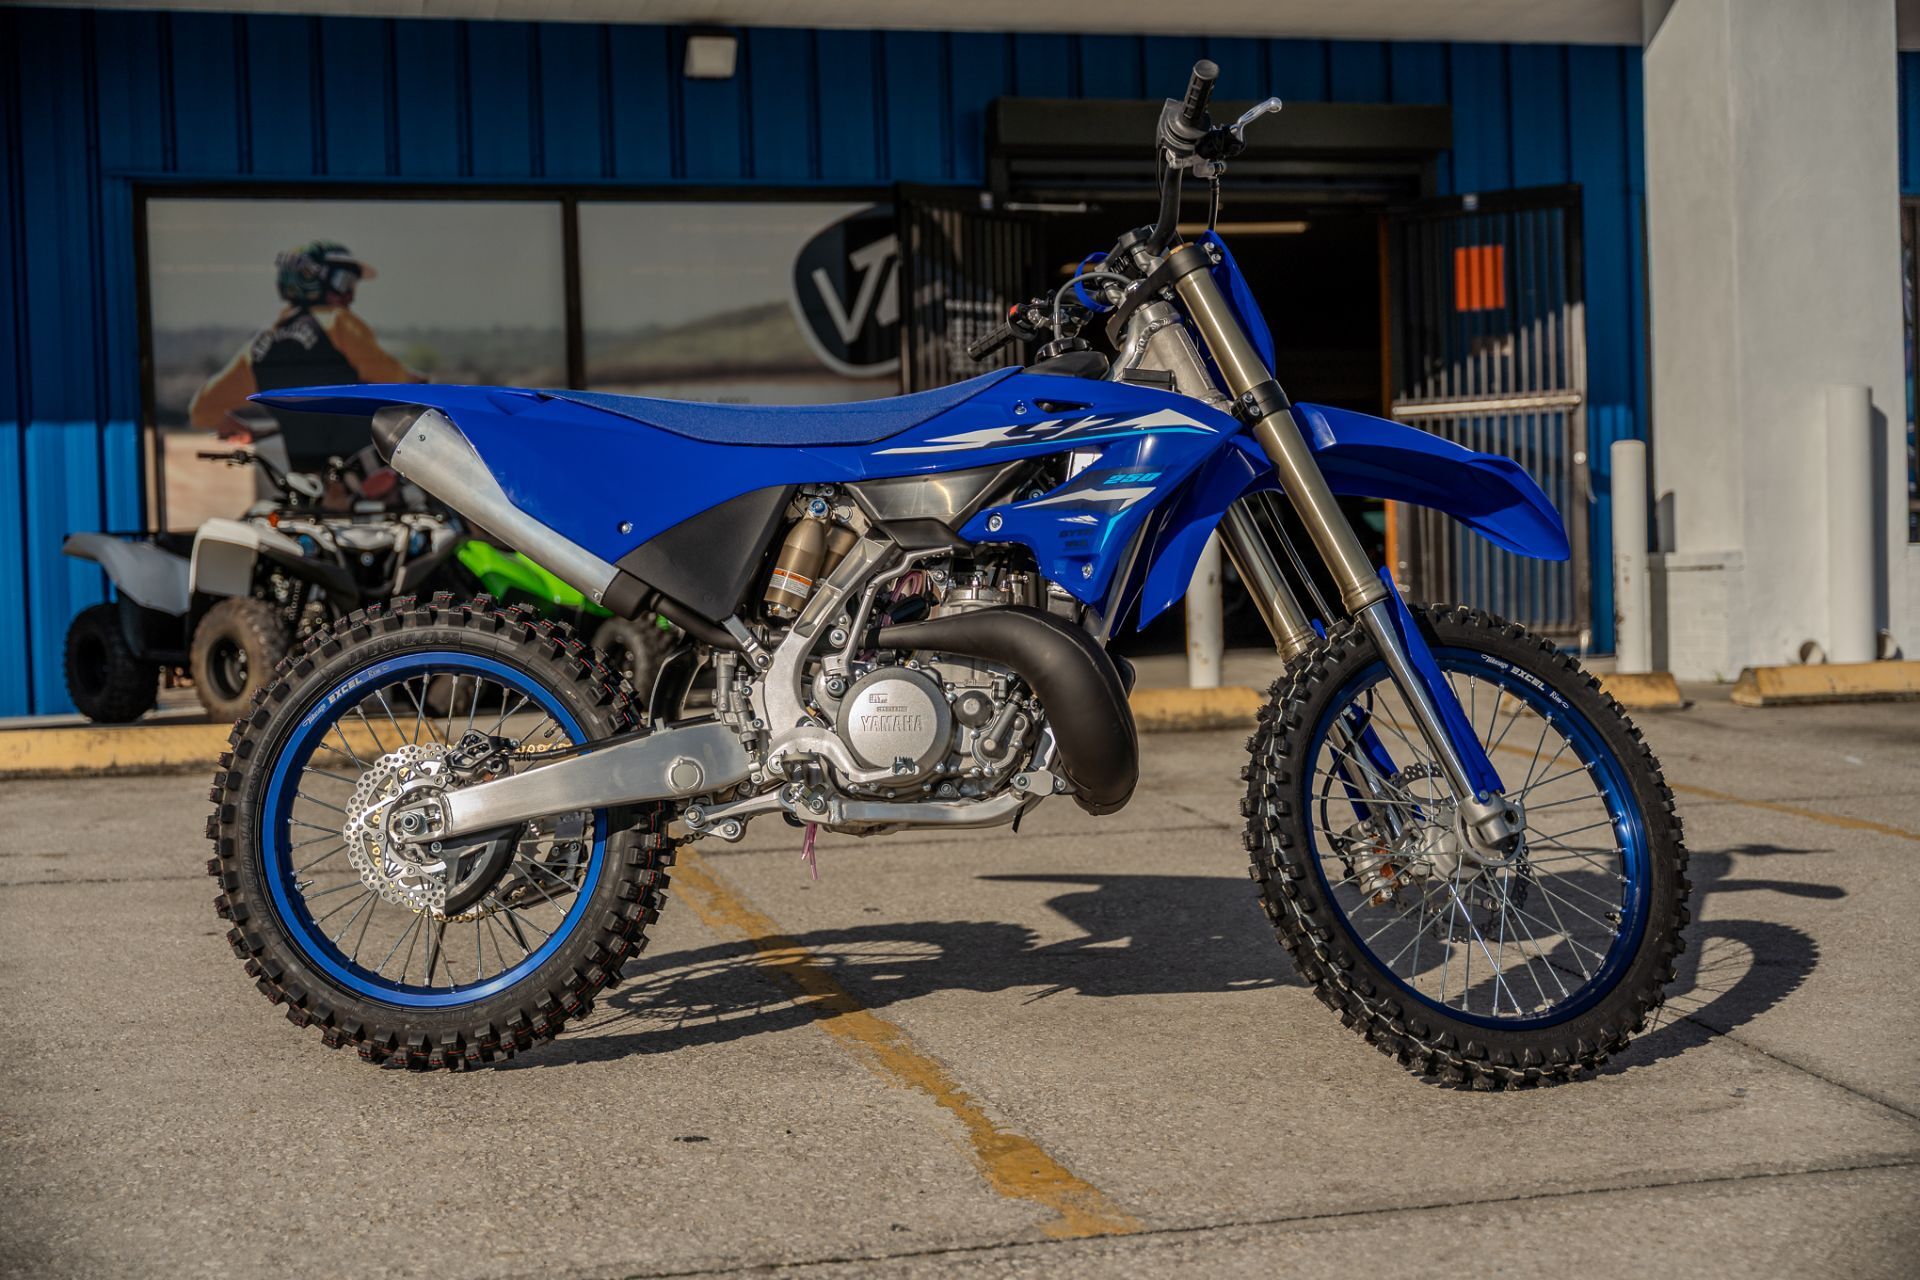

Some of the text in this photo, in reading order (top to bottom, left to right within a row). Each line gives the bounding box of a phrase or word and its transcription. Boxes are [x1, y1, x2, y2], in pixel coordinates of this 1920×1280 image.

[1103, 472, 1162, 485] 250
[1510, 665, 1546, 691] EXCEL
[328, 677, 363, 704] EXCEL
[860, 714, 923, 733] YAMAHA
